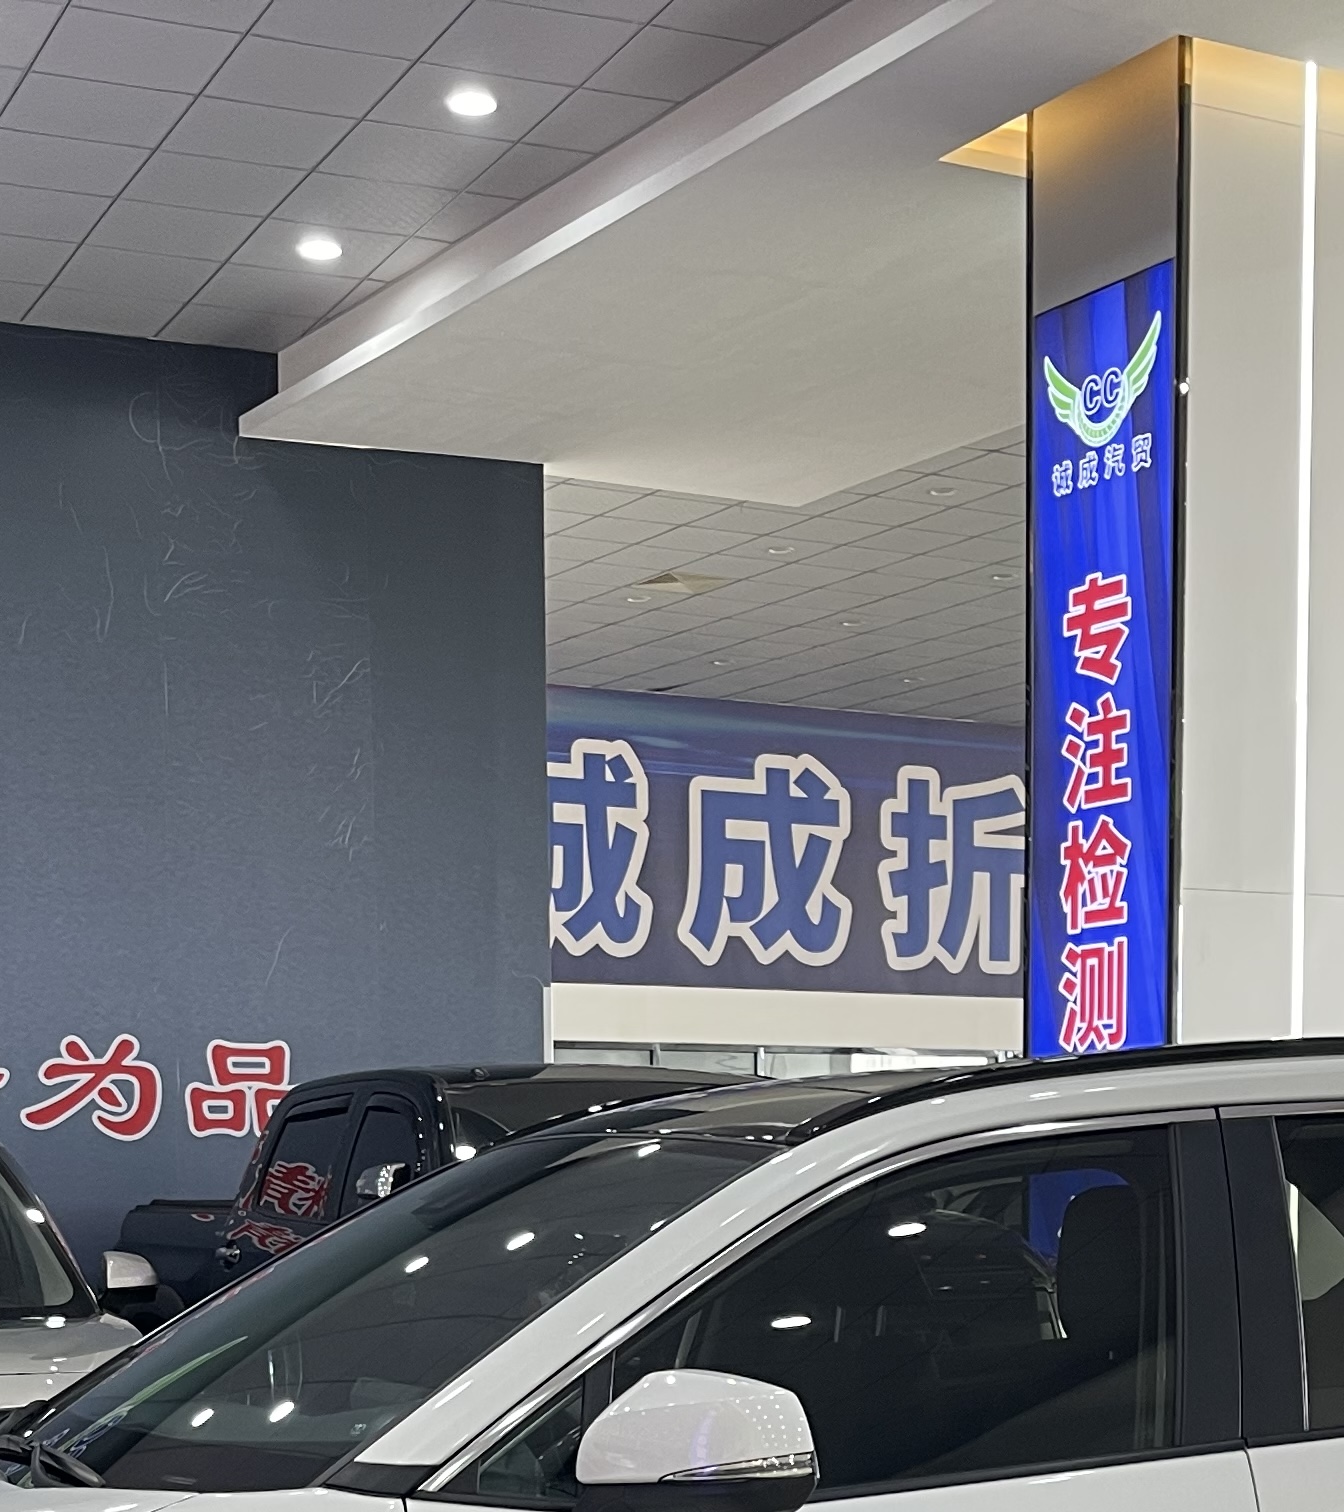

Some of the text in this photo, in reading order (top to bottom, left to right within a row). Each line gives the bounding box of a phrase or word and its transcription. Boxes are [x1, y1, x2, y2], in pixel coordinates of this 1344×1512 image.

[1081, 367, 1123, 416] CC
[1051, 433, 1153, 498] 诚成汽贸
[1059, 571, 1132, 1053] 专注检测
